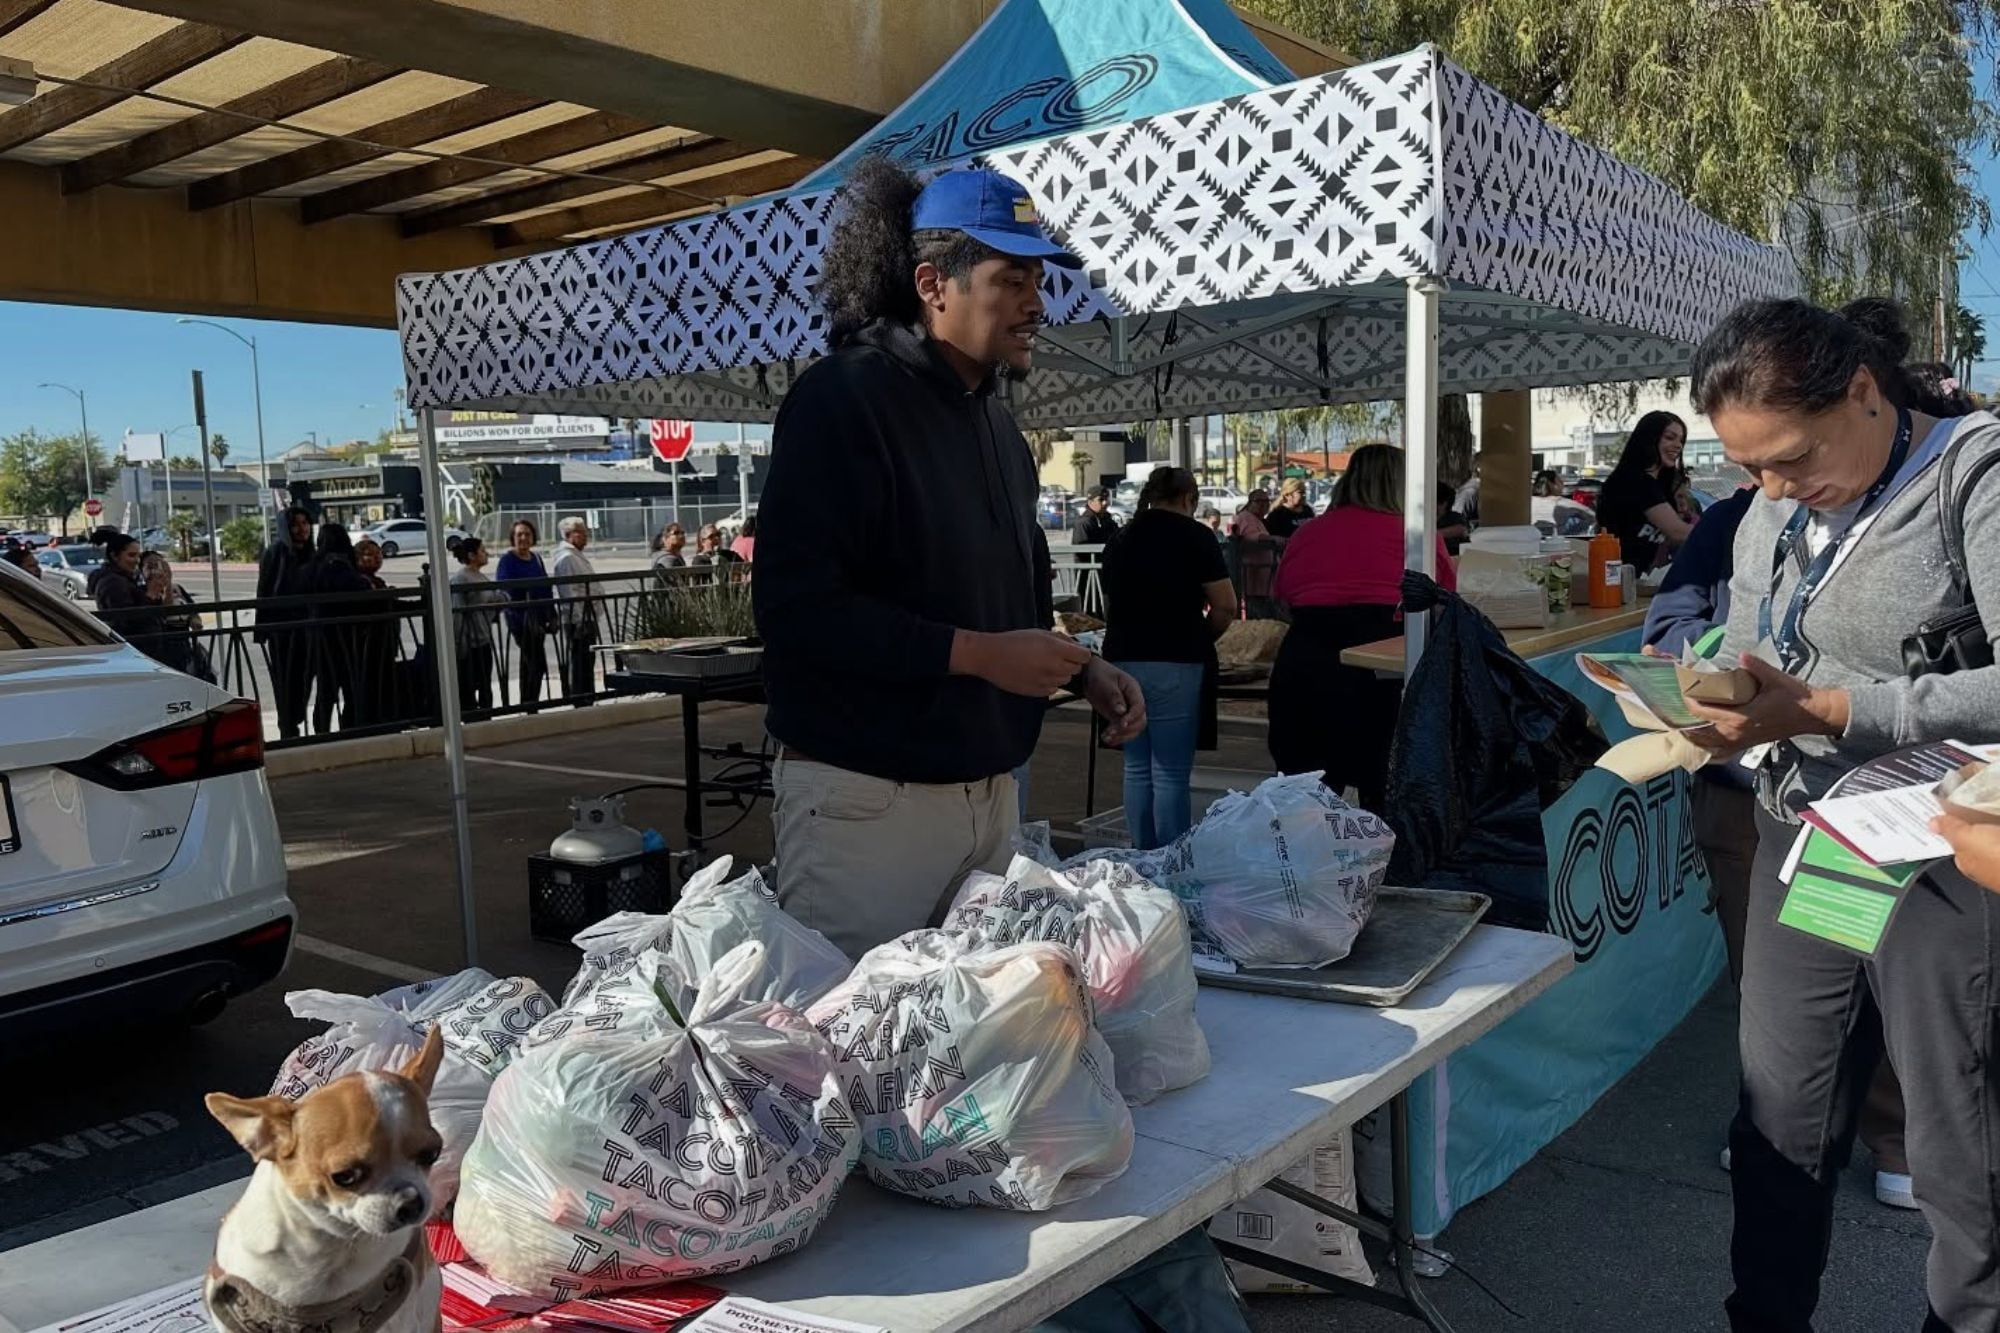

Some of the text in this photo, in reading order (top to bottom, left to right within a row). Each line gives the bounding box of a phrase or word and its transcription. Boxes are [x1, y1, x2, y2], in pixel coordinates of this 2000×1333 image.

[866, 53, 1159, 163] TACO
[444, 424, 595, 438] BILLIONS WON FOR OUR CLIENTS
[653, 420, 691, 440] STOP
[321, 478, 367, 495] TATTOO
[167, 701, 192, 715] SR
